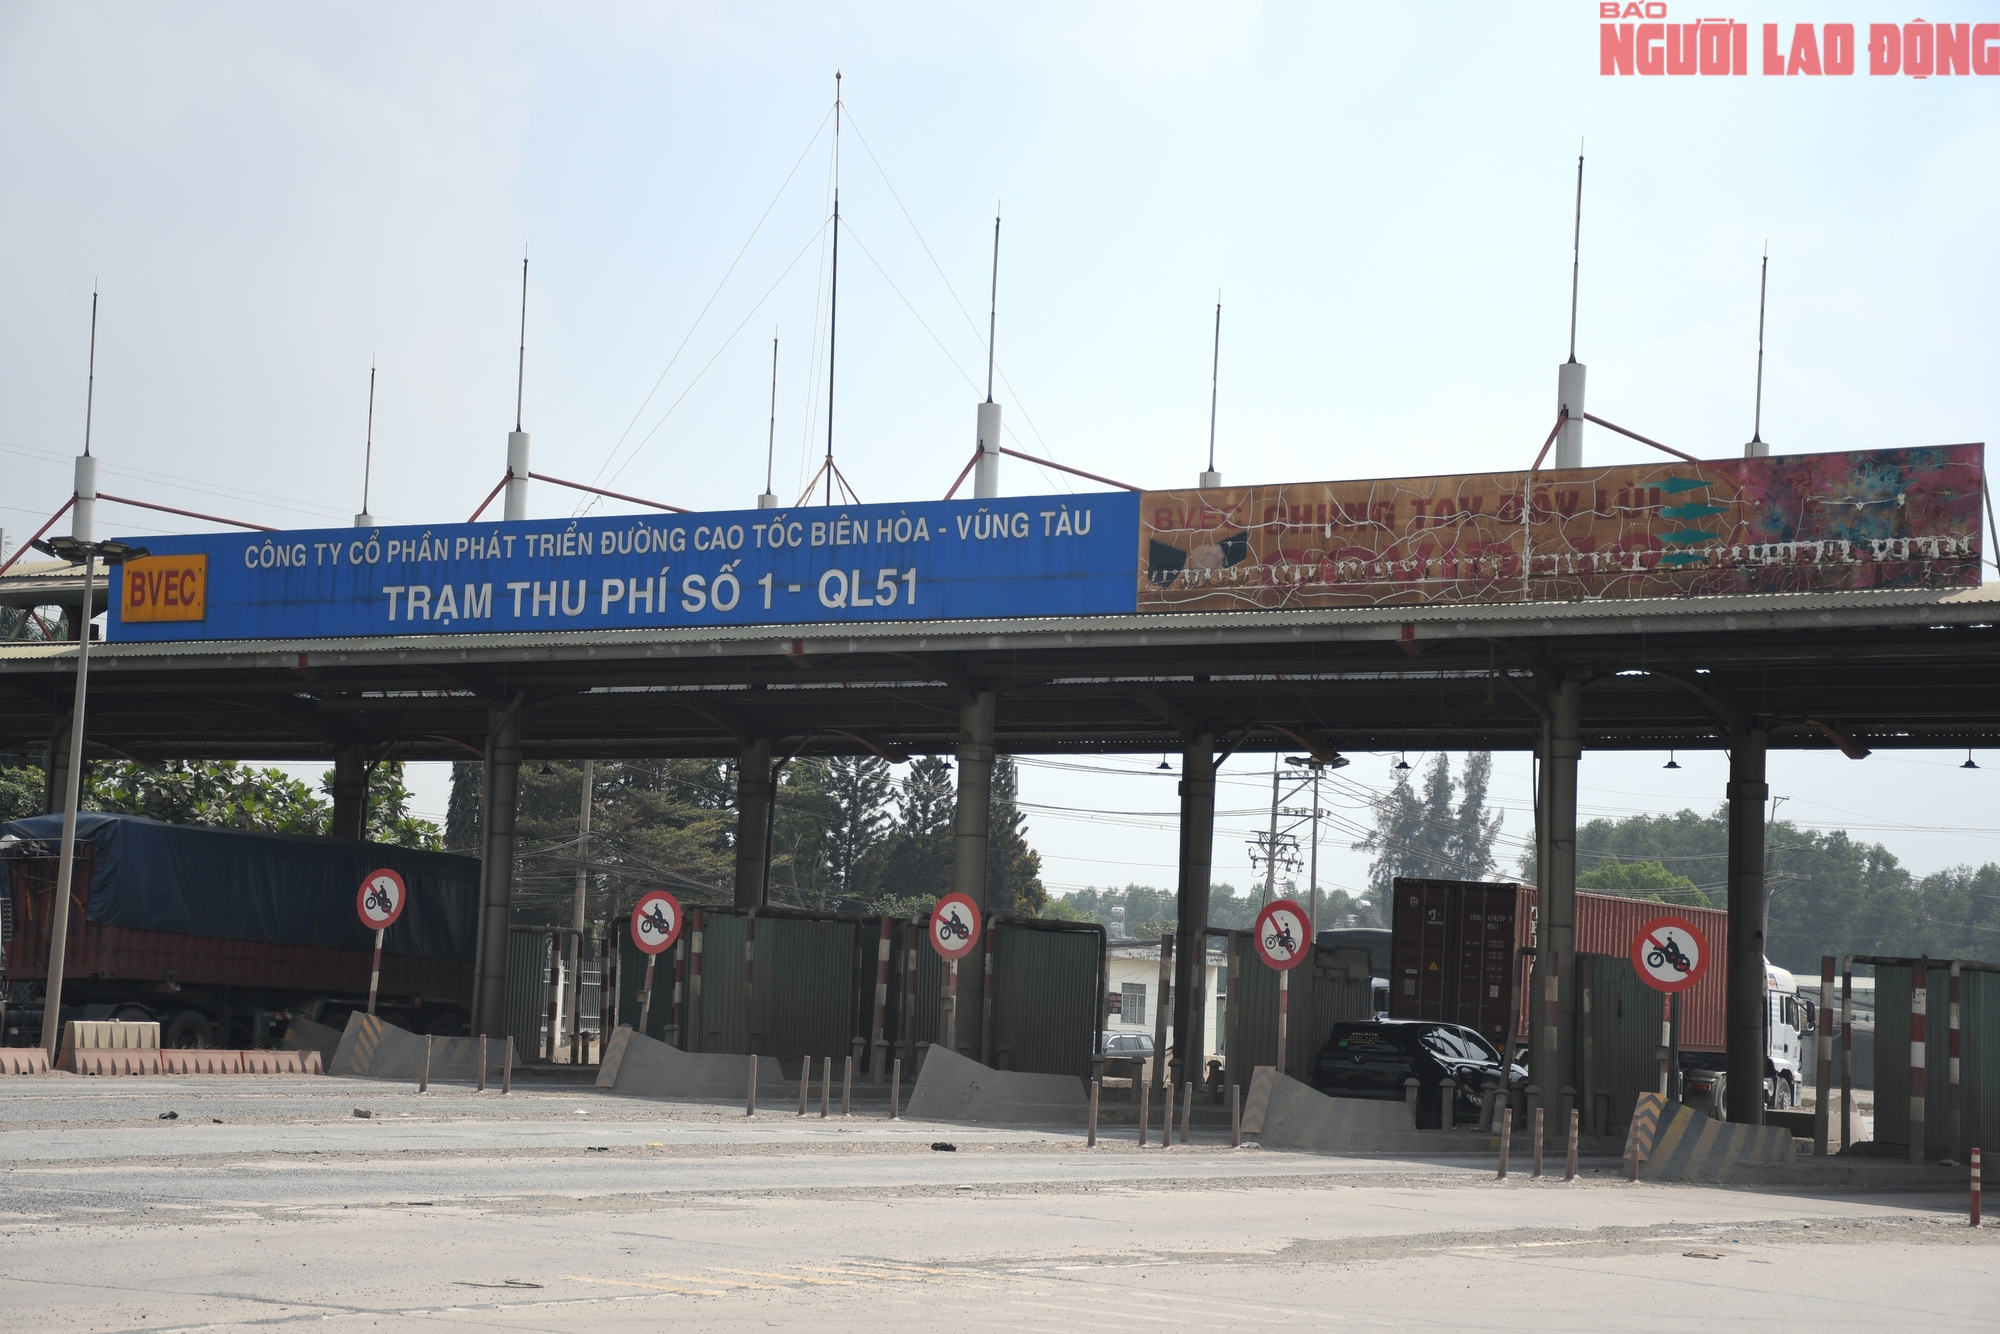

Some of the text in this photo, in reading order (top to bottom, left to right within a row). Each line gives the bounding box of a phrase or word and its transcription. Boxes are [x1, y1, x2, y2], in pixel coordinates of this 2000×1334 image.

[244, 539, 307, 568] CÔNG
[314, 543, 343, 566] TY
[349, 529, 381, 565] CỔ
[387, 530, 449, 563] PHẦN
[455, 530, 517, 561] PHÁT
[525, 521, 594, 559] TRIỂN
[601, 521, 687, 556] ĐƯỜNG
[694, 525, 745, 552] CAO
[752, 514, 804, 549] TỐC
[811, 514, 870, 548] BIÊN
[876, 509, 931, 544] HÒA
[957, 508, 1030, 541] VŨNG
[1040, 504, 1092, 537] TÀU
[1154, 504, 1243, 532] BVEC
[1263, 501, 1396, 536] CHUNG
[1411, 496, 1484, 530] TAY
[129, 569, 197, 608] BVEC
[382, 559, 917, 625] TRẠM THU PHÍ SỐ 1 - QL51
